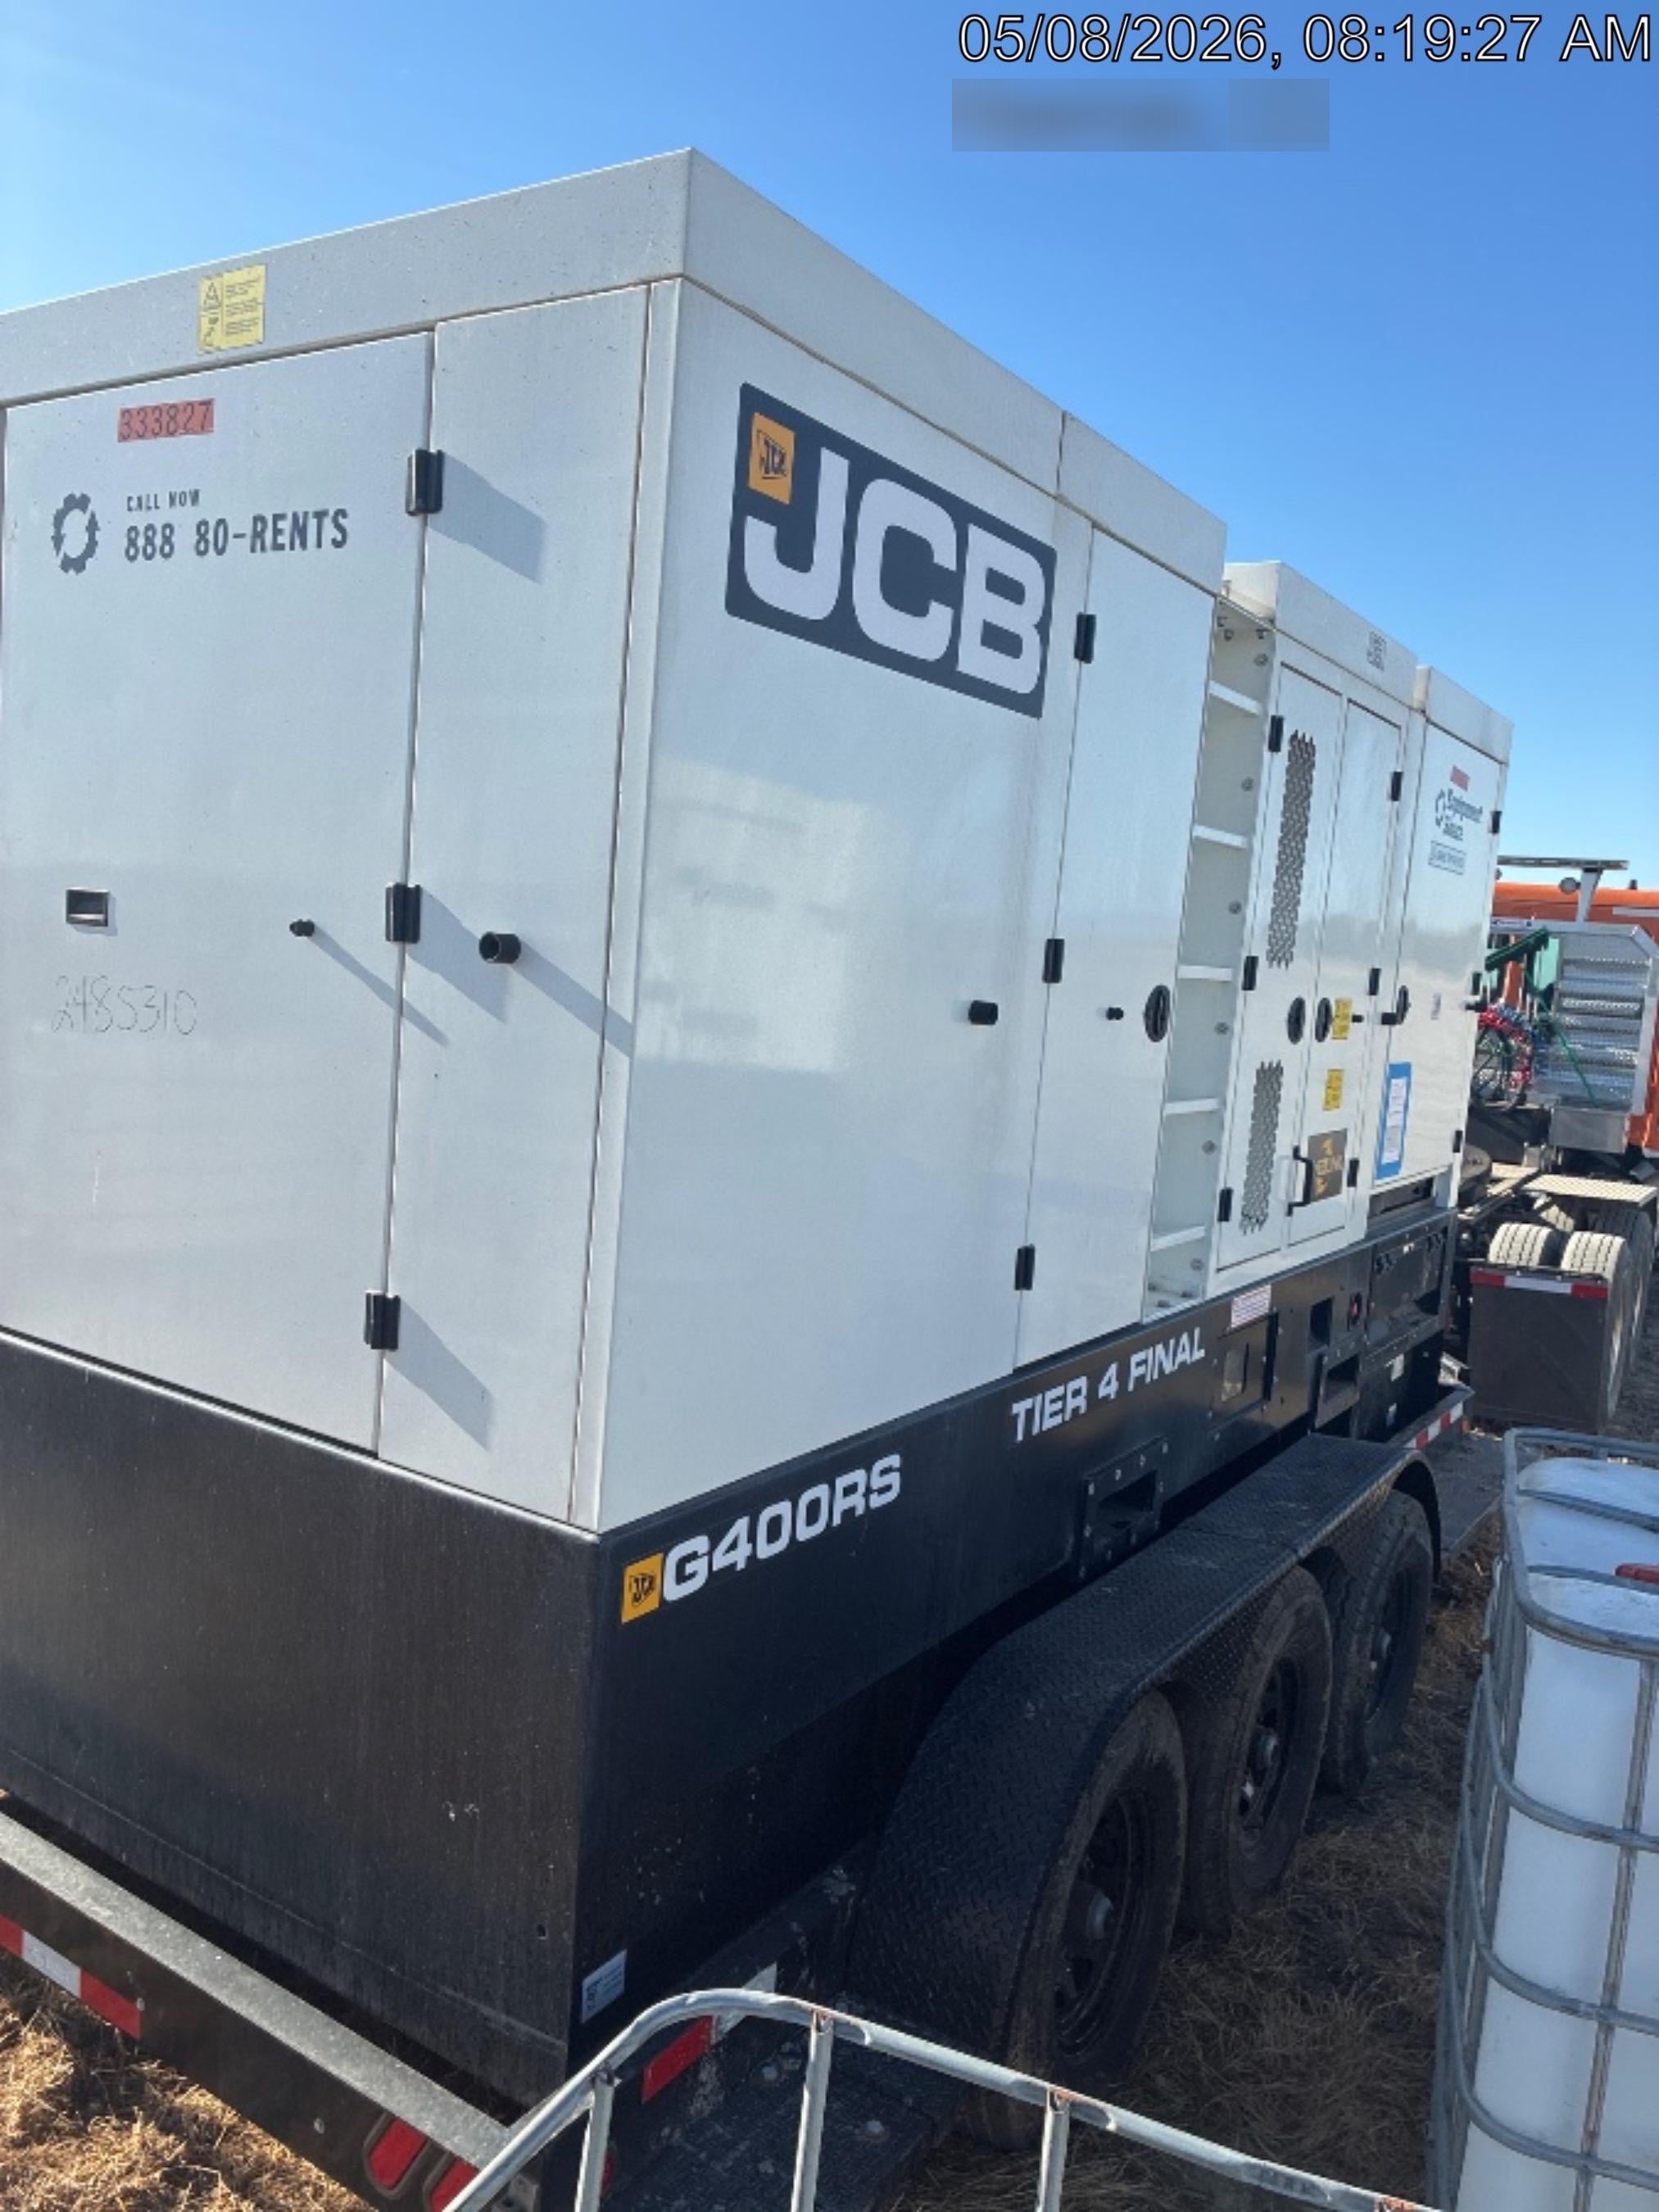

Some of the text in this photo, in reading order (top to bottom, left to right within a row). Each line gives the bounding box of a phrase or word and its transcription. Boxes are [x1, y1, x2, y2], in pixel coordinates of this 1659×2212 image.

[120, 400, 212, 441] 333827
[125, 508, 350, 563] 888 80-RENTS
[126, 489, 201, 512] CALL NOW
[743, 446, 1046, 695] JCB
[1011, 1326, 1206, 1444] TIER 4 FINAL
[662, 1453, 903, 1602] G400RS
